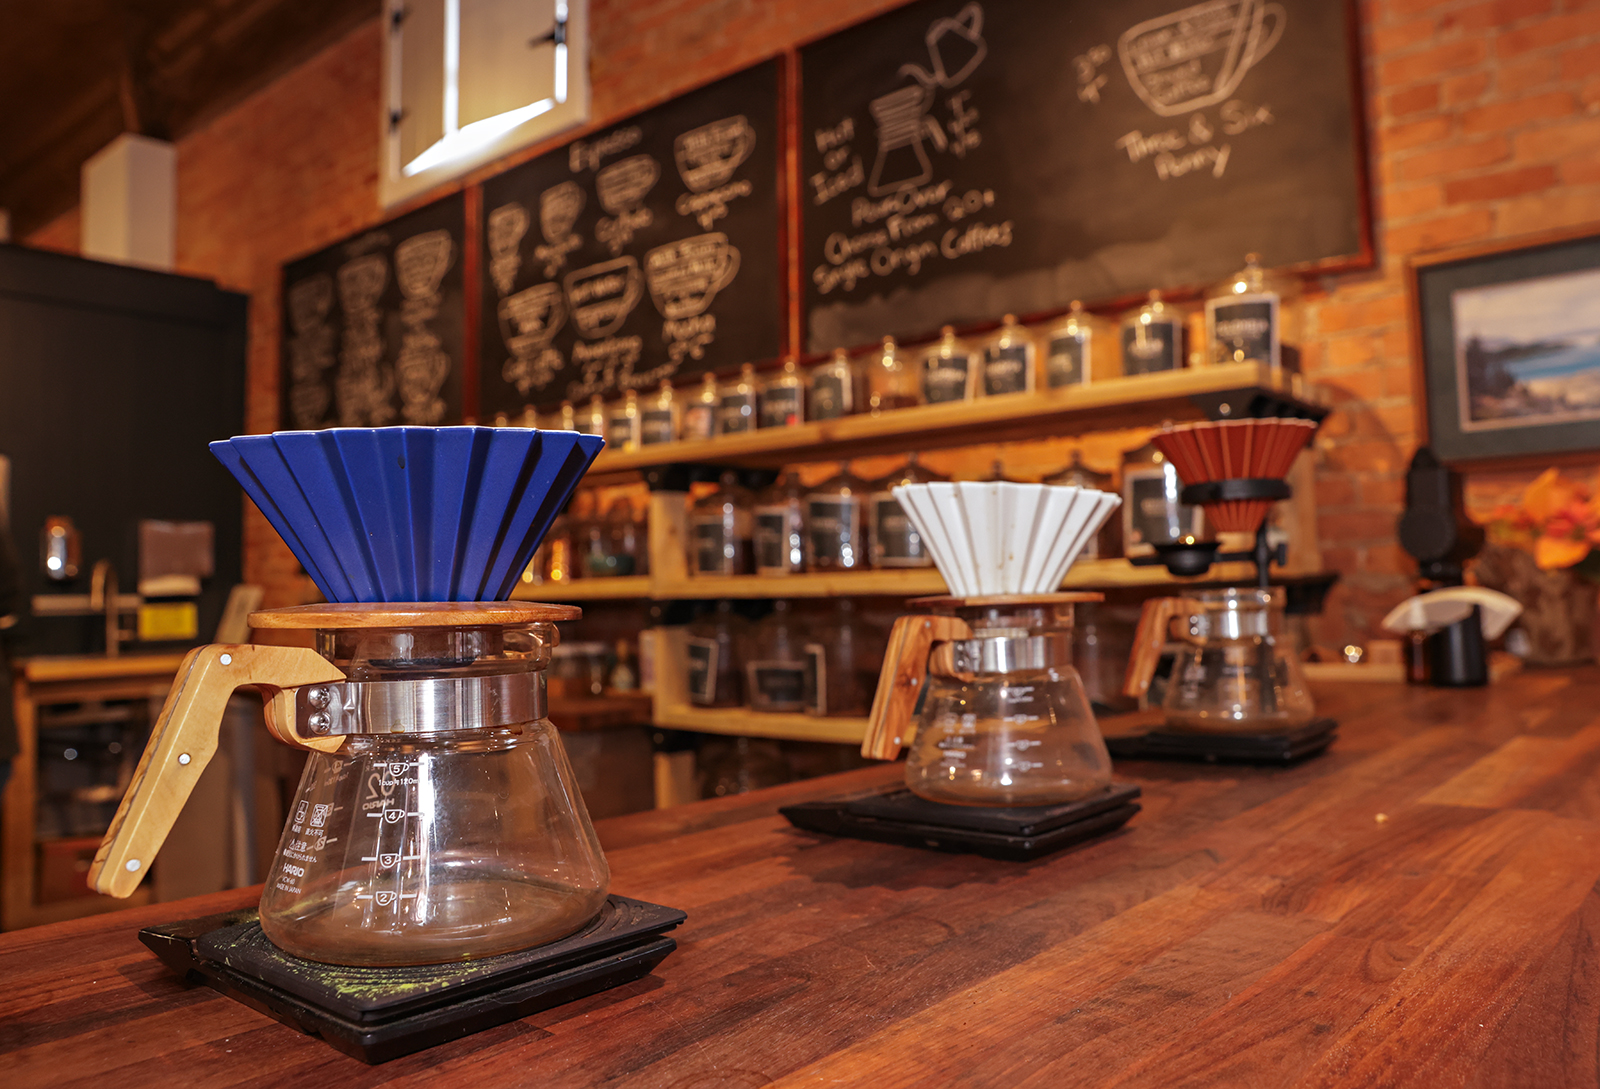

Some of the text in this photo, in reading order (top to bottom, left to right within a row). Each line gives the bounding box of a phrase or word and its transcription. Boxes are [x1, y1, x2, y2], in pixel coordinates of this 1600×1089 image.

[815, 117, 856, 153] Hot
[1114, 129, 1187, 164] Three
[1188, 113, 1215, 146] &
[1154, 143, 1231, 181] Penny
[887, 212, 938, 241] From
[813, 219, 1014, 294] Single Origin Coffees
[393, 765, 400, 773] 5
[388, 811, 396, 820] 4
[384, 856, 392, 864] 3
[282, 862, 305, 877] HARIO
[288, 886, 302, 894] JAPAN
[380, 894, 388, 902] 2
